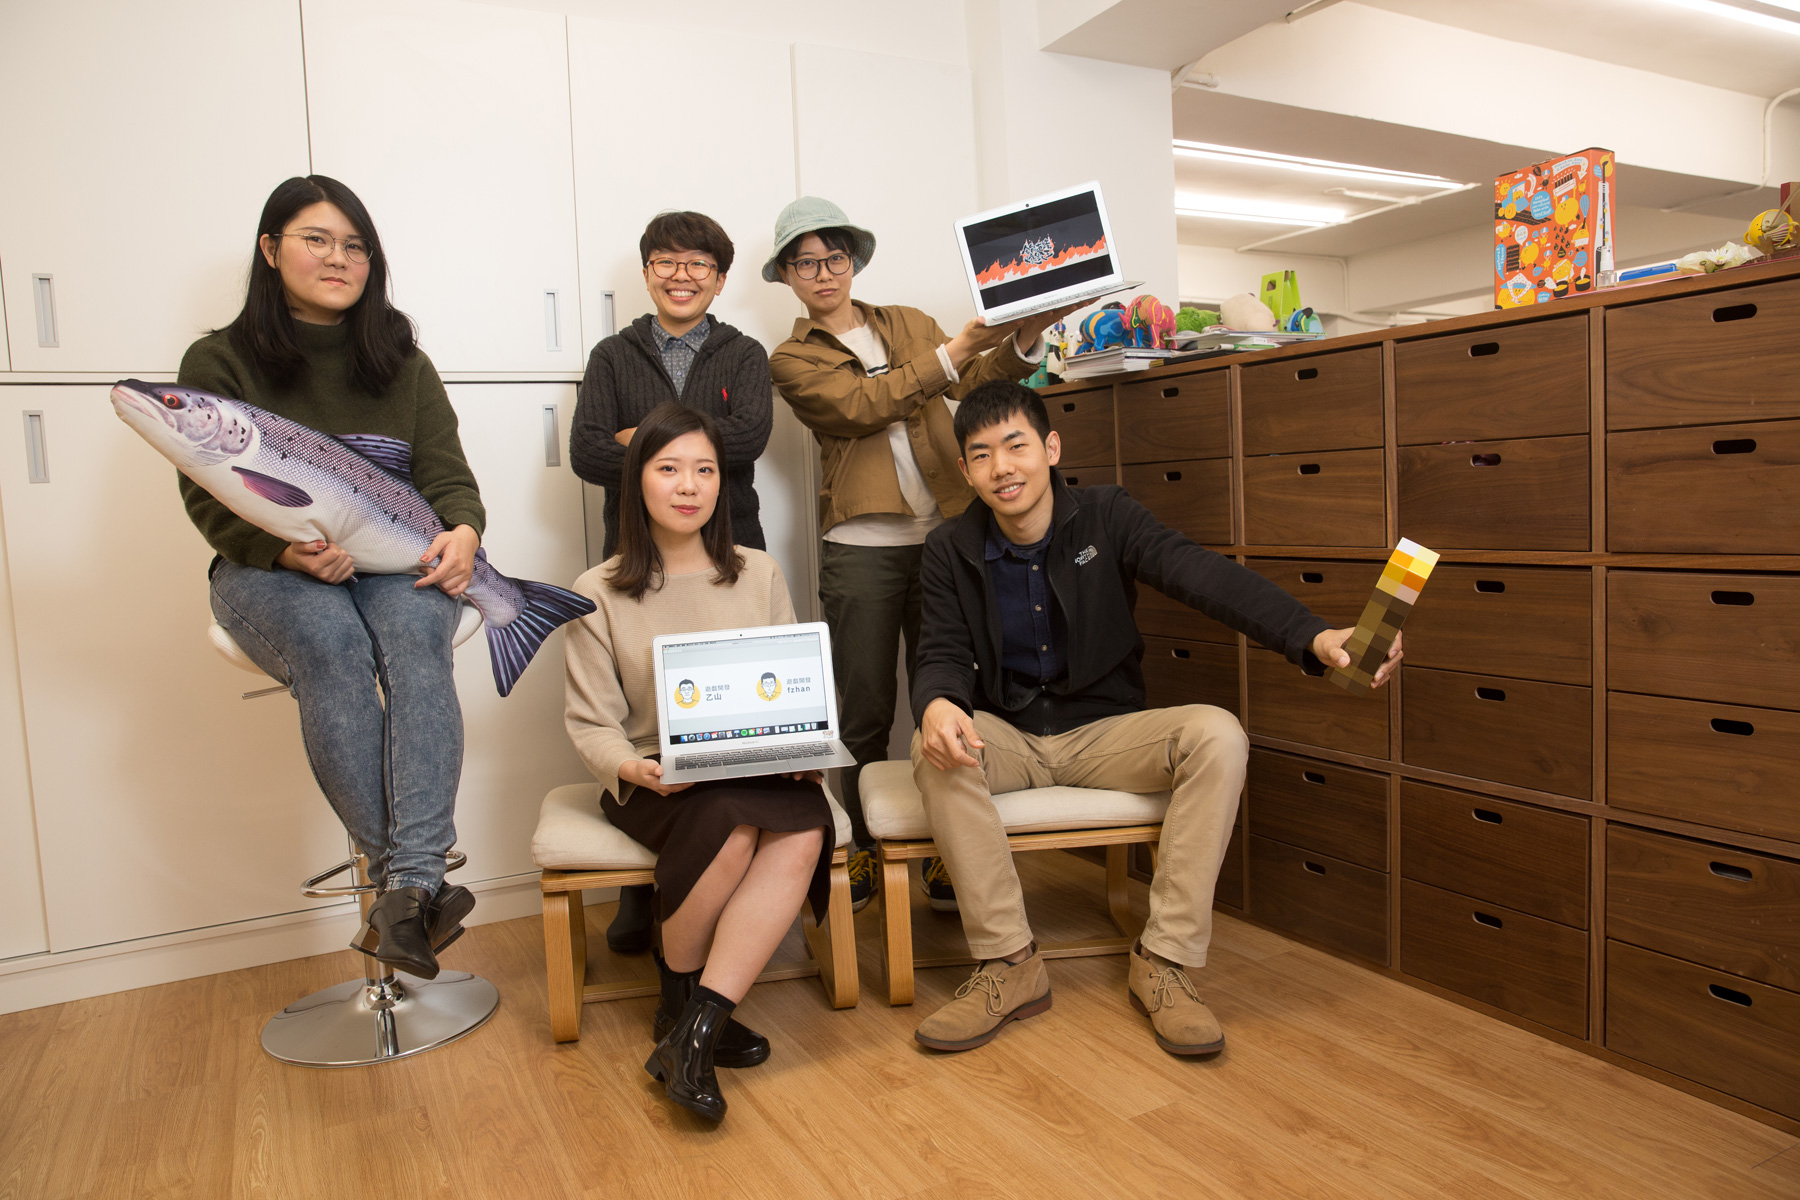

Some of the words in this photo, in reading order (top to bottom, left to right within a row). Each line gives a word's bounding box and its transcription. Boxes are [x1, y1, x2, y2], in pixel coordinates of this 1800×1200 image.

[1078, 548, 1089, 556] THE
[1079, 556, 1091, 566] FACE
[706, 693, 722, 701] 乙山
